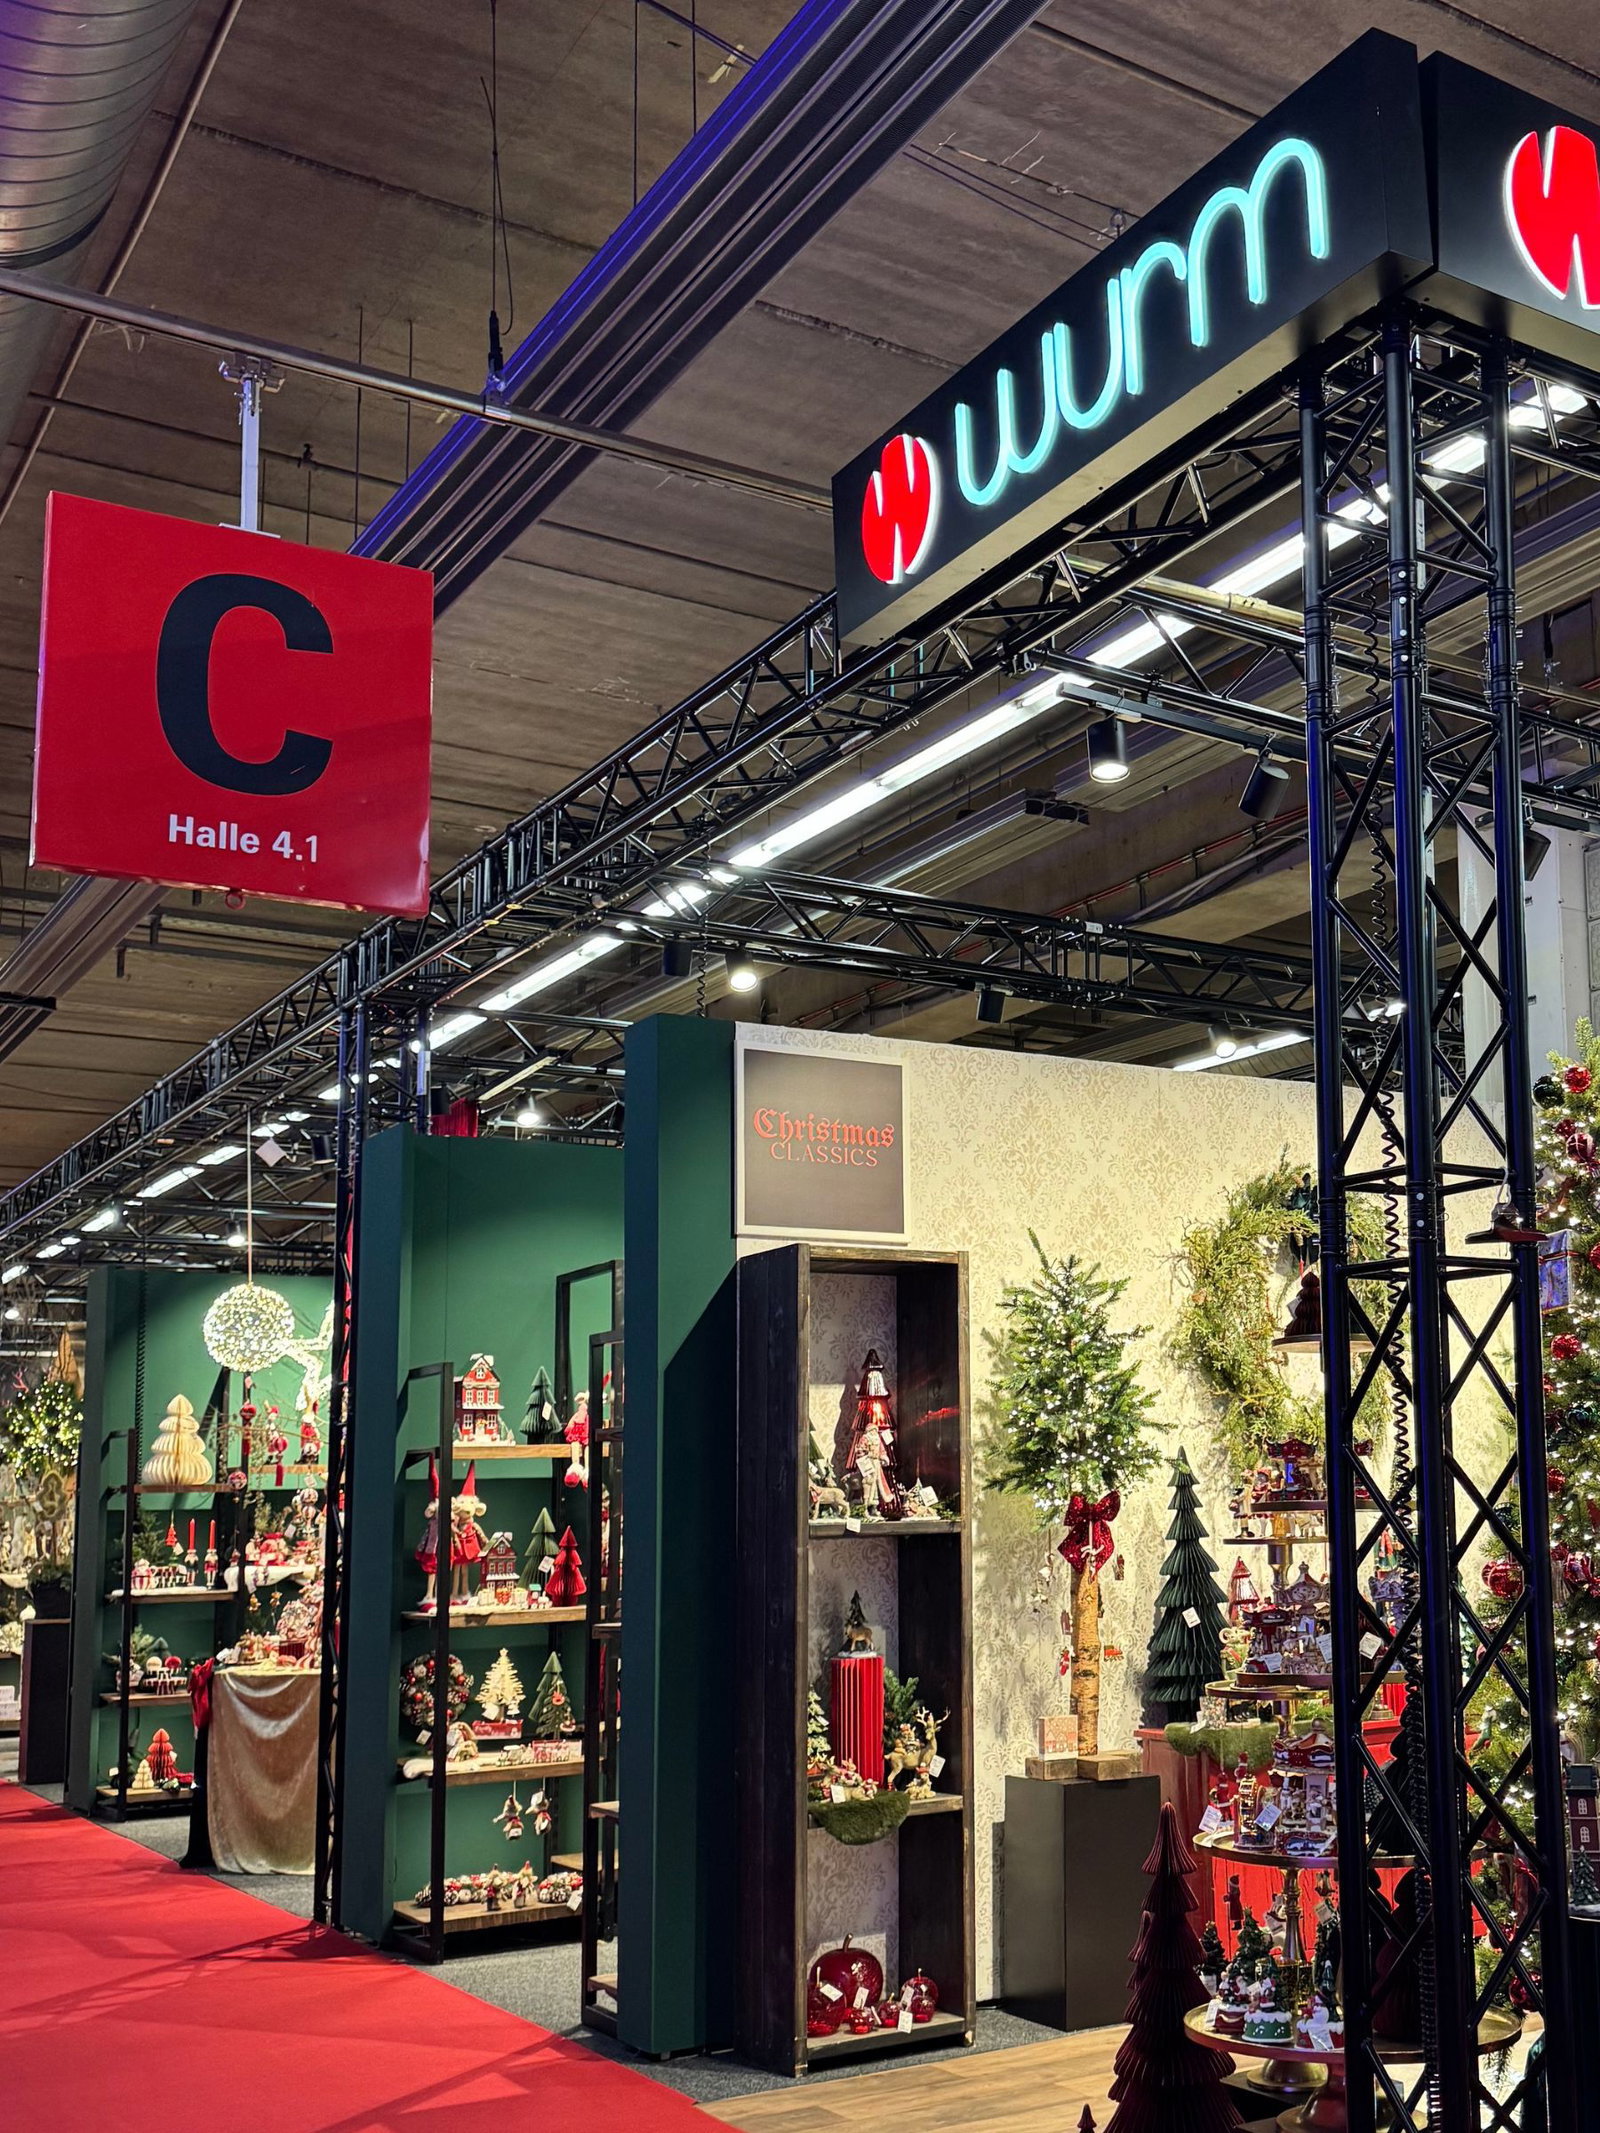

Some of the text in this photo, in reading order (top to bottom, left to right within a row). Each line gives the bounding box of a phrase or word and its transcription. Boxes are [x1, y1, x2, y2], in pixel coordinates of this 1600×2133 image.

[954, 136, 1329, 507] wurm
[156, 573, 333, 796] C
[168, 813, 318, 863] Halle 4.1
[753, 1107, 895, 1148] Christmas
[770, 1142, 879, 1167] CLASSICS
